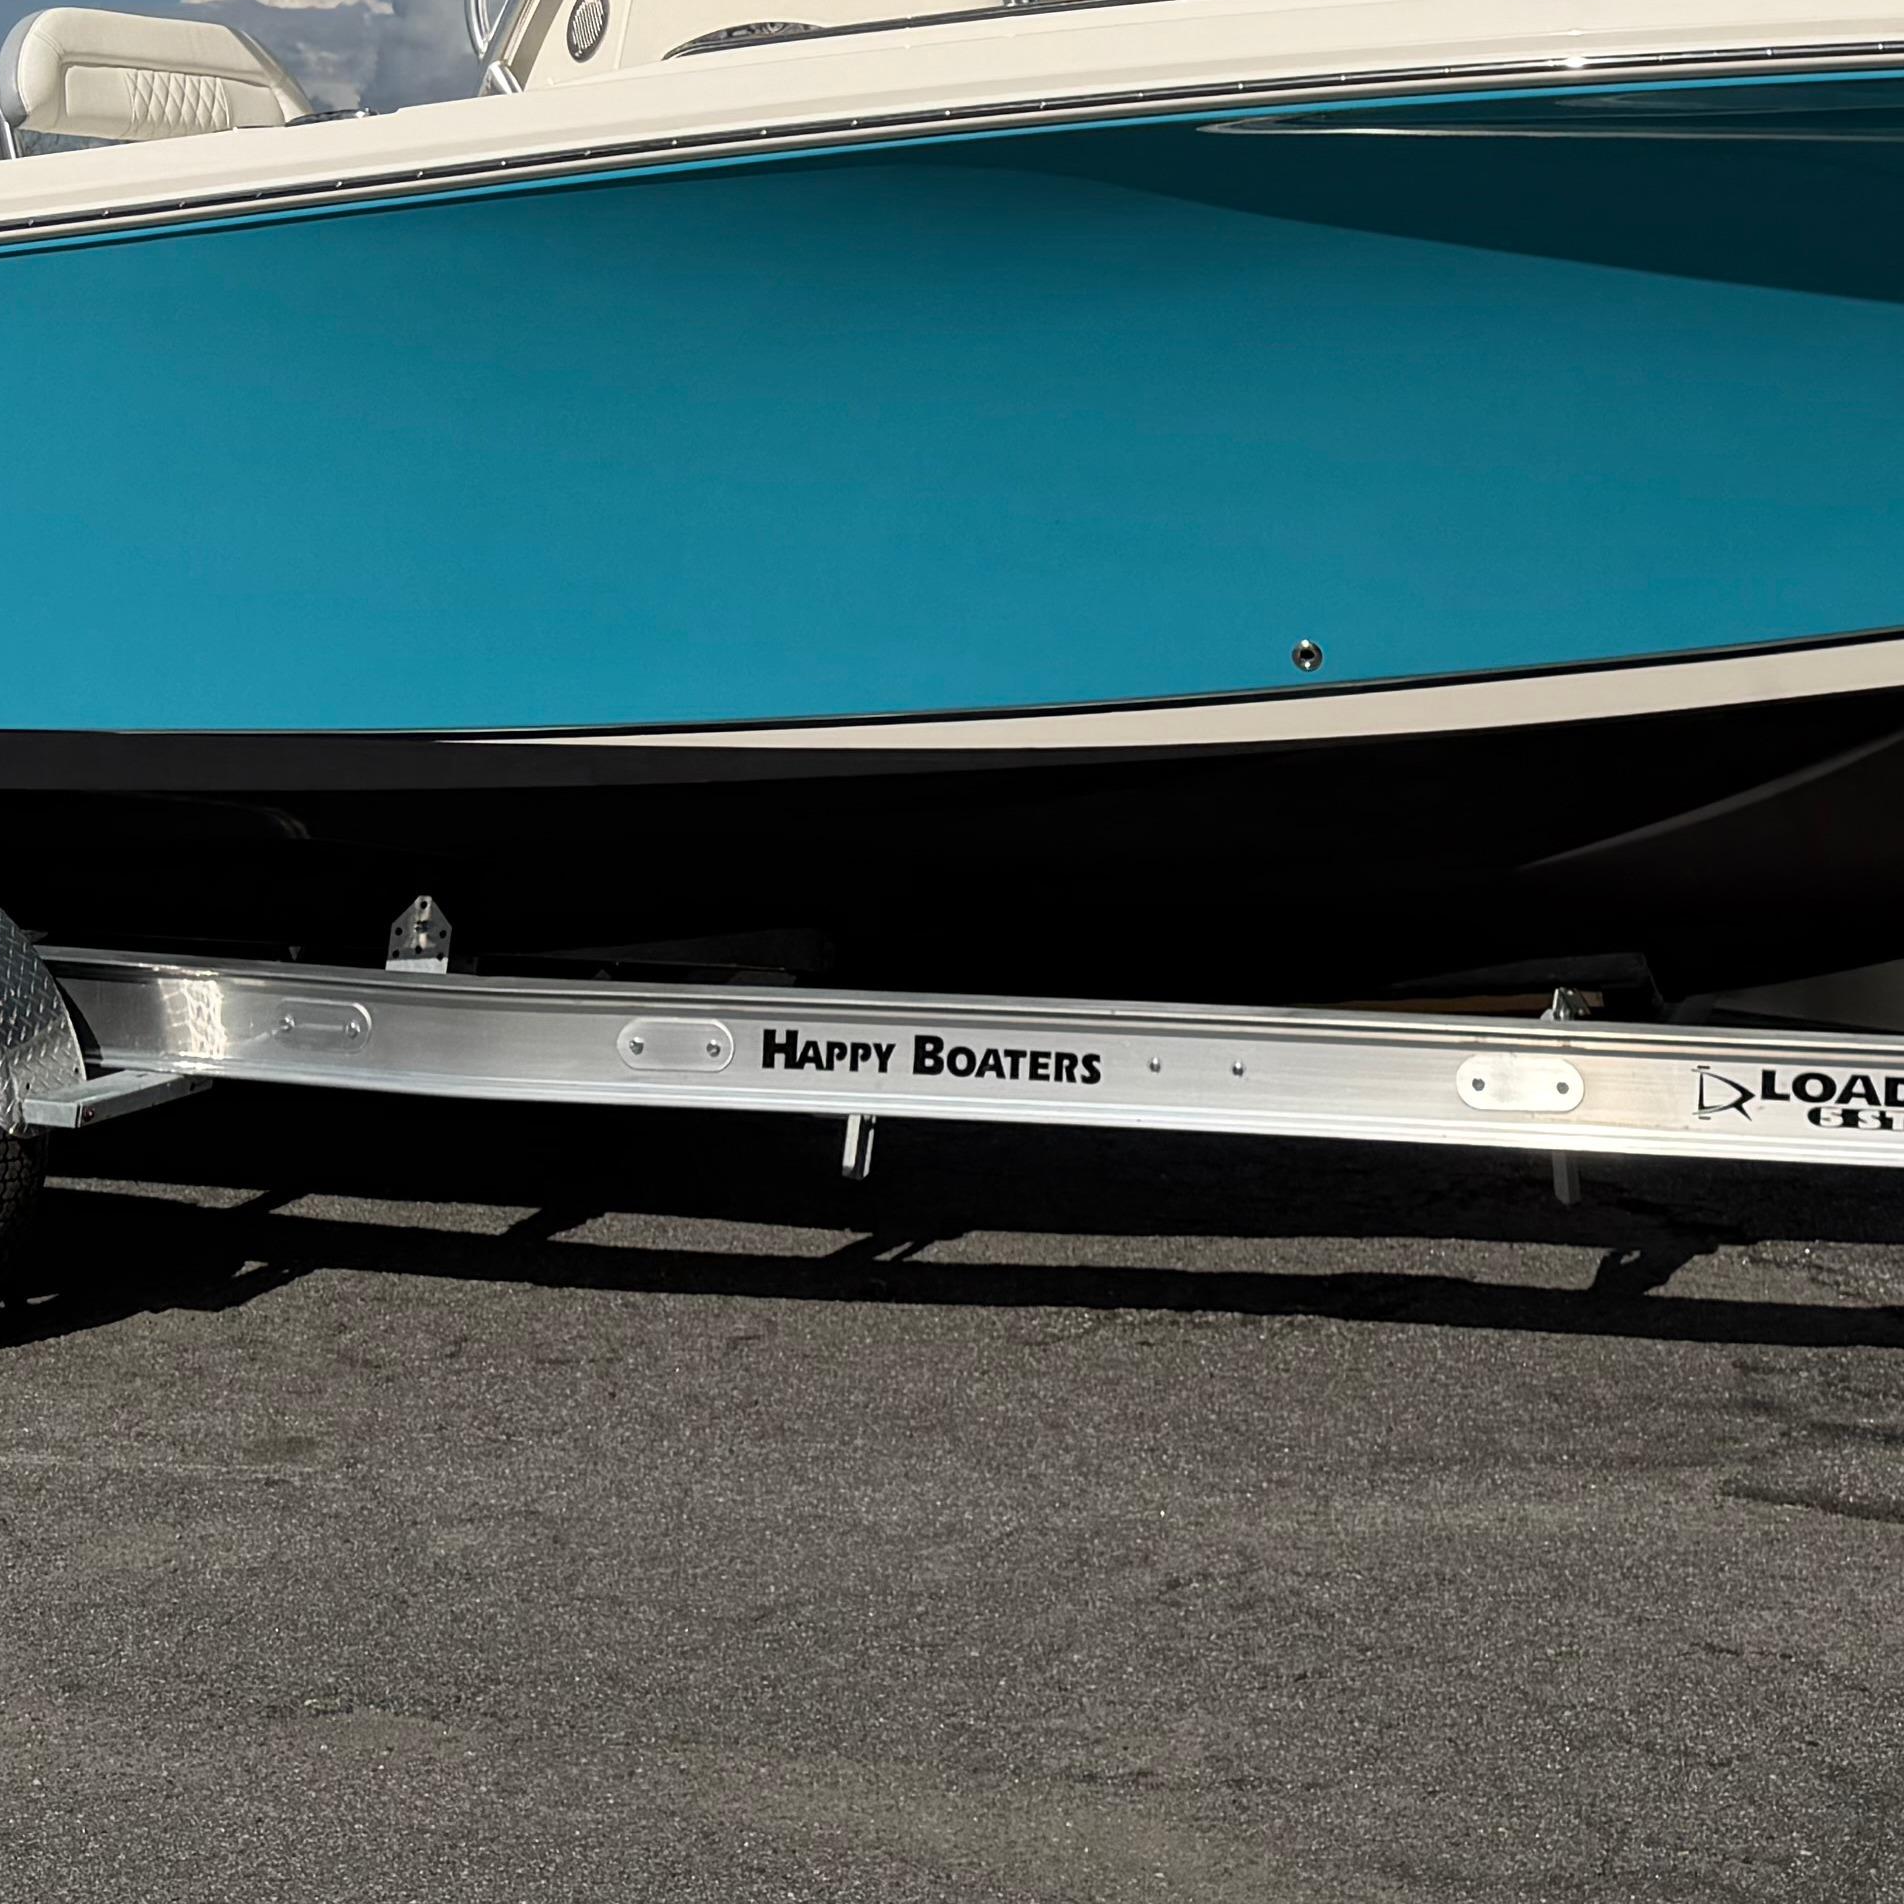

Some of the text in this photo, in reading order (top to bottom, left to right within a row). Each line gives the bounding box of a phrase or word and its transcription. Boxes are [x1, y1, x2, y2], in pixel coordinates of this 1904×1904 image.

[762, 1028, 1102, 1085] HAPPY BOATERS
[1819, 1106, 1844, 1128] 5
